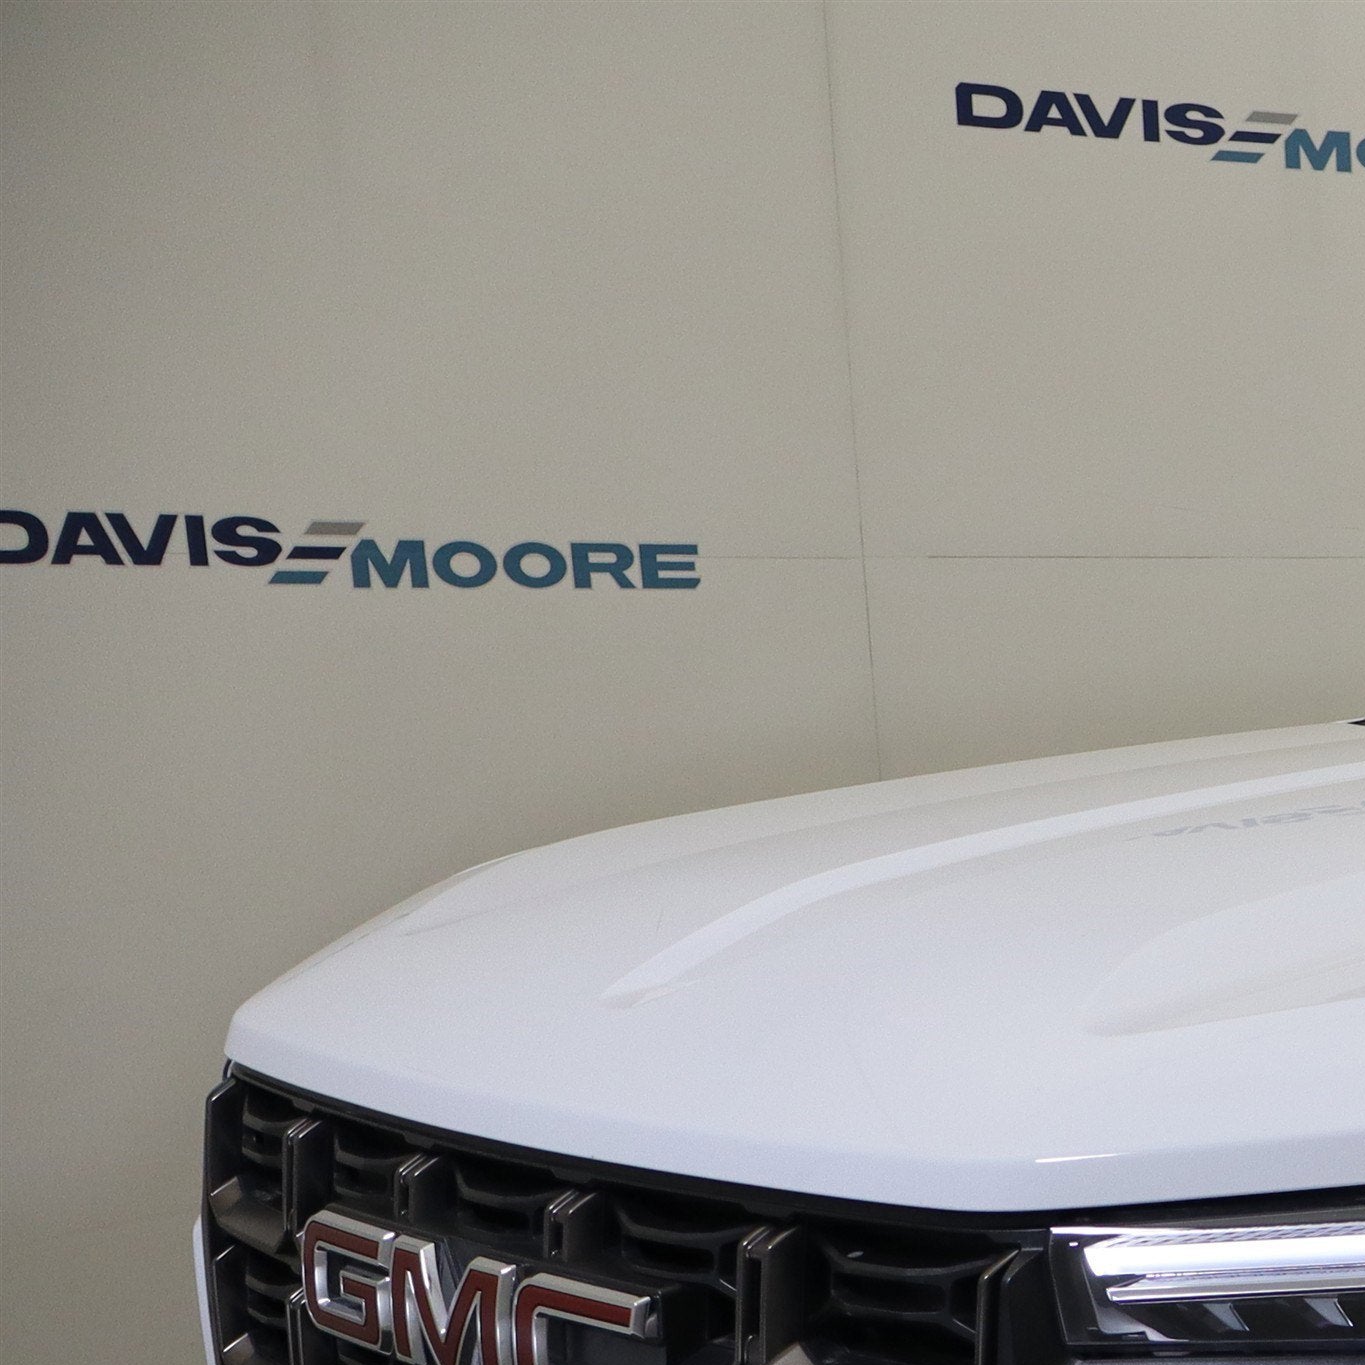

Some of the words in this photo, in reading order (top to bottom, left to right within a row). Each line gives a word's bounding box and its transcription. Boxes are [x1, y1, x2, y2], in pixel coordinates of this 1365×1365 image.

[955, 81, 1226, 147] DAVIS
[0, 508, 283, 568] DAVIS
[351, 538, 702, 590] MOORE
